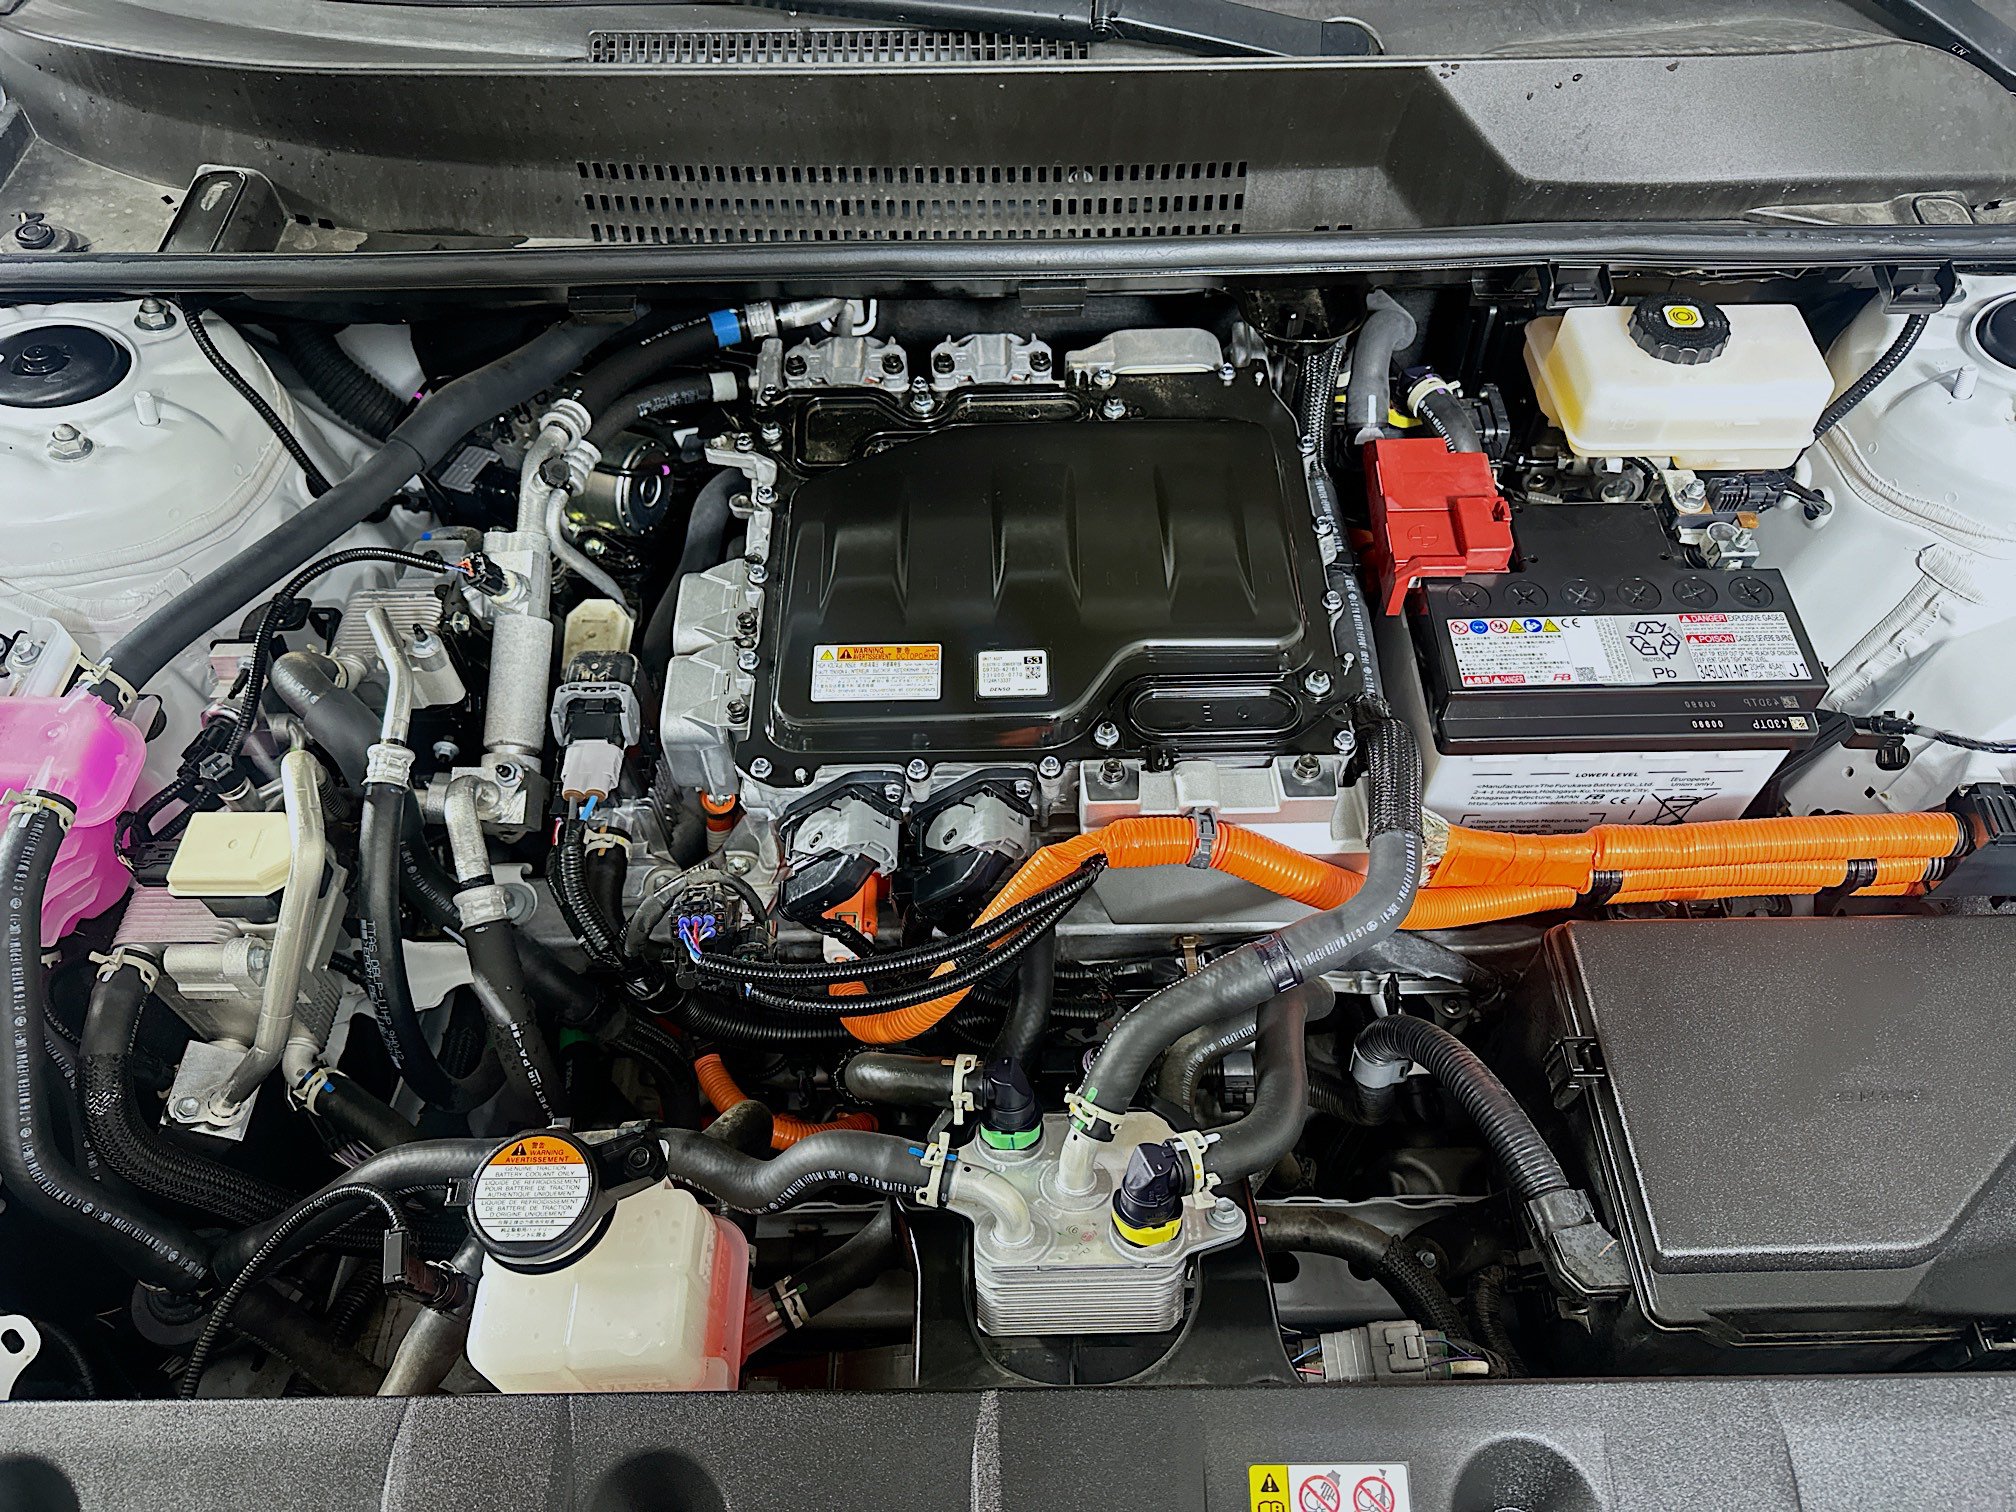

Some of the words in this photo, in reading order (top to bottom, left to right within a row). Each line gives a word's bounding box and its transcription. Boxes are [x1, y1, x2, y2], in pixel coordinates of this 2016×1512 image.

[1698, 635, 1734, 643] POISON
[1027, 656, 1040, 664] 53
[1652, 667, 1677, 678] Pb
[1698, 663, 1748, 679] 345LN1-MF
[1788, 663, 1809, 678] J1
[1501, 675, 1524, 684] DANGER
[1752, 719, 1788, 729] 43DTP
[17, 846, 36, 871] WATER
[28, 819, 45, 845] >EPDM<
[1405, 849, 1416, 873] WATER
[366, 921, 377, 953] TTAS
[1324, 936, 1348, 956] WATER
[11, 967, 26, 993] WATER
[18, 1079, 31, 1104] WATER
[827, 1169, 846, 1180] UK-11
[881, 1181, 907, 1193] WATER
